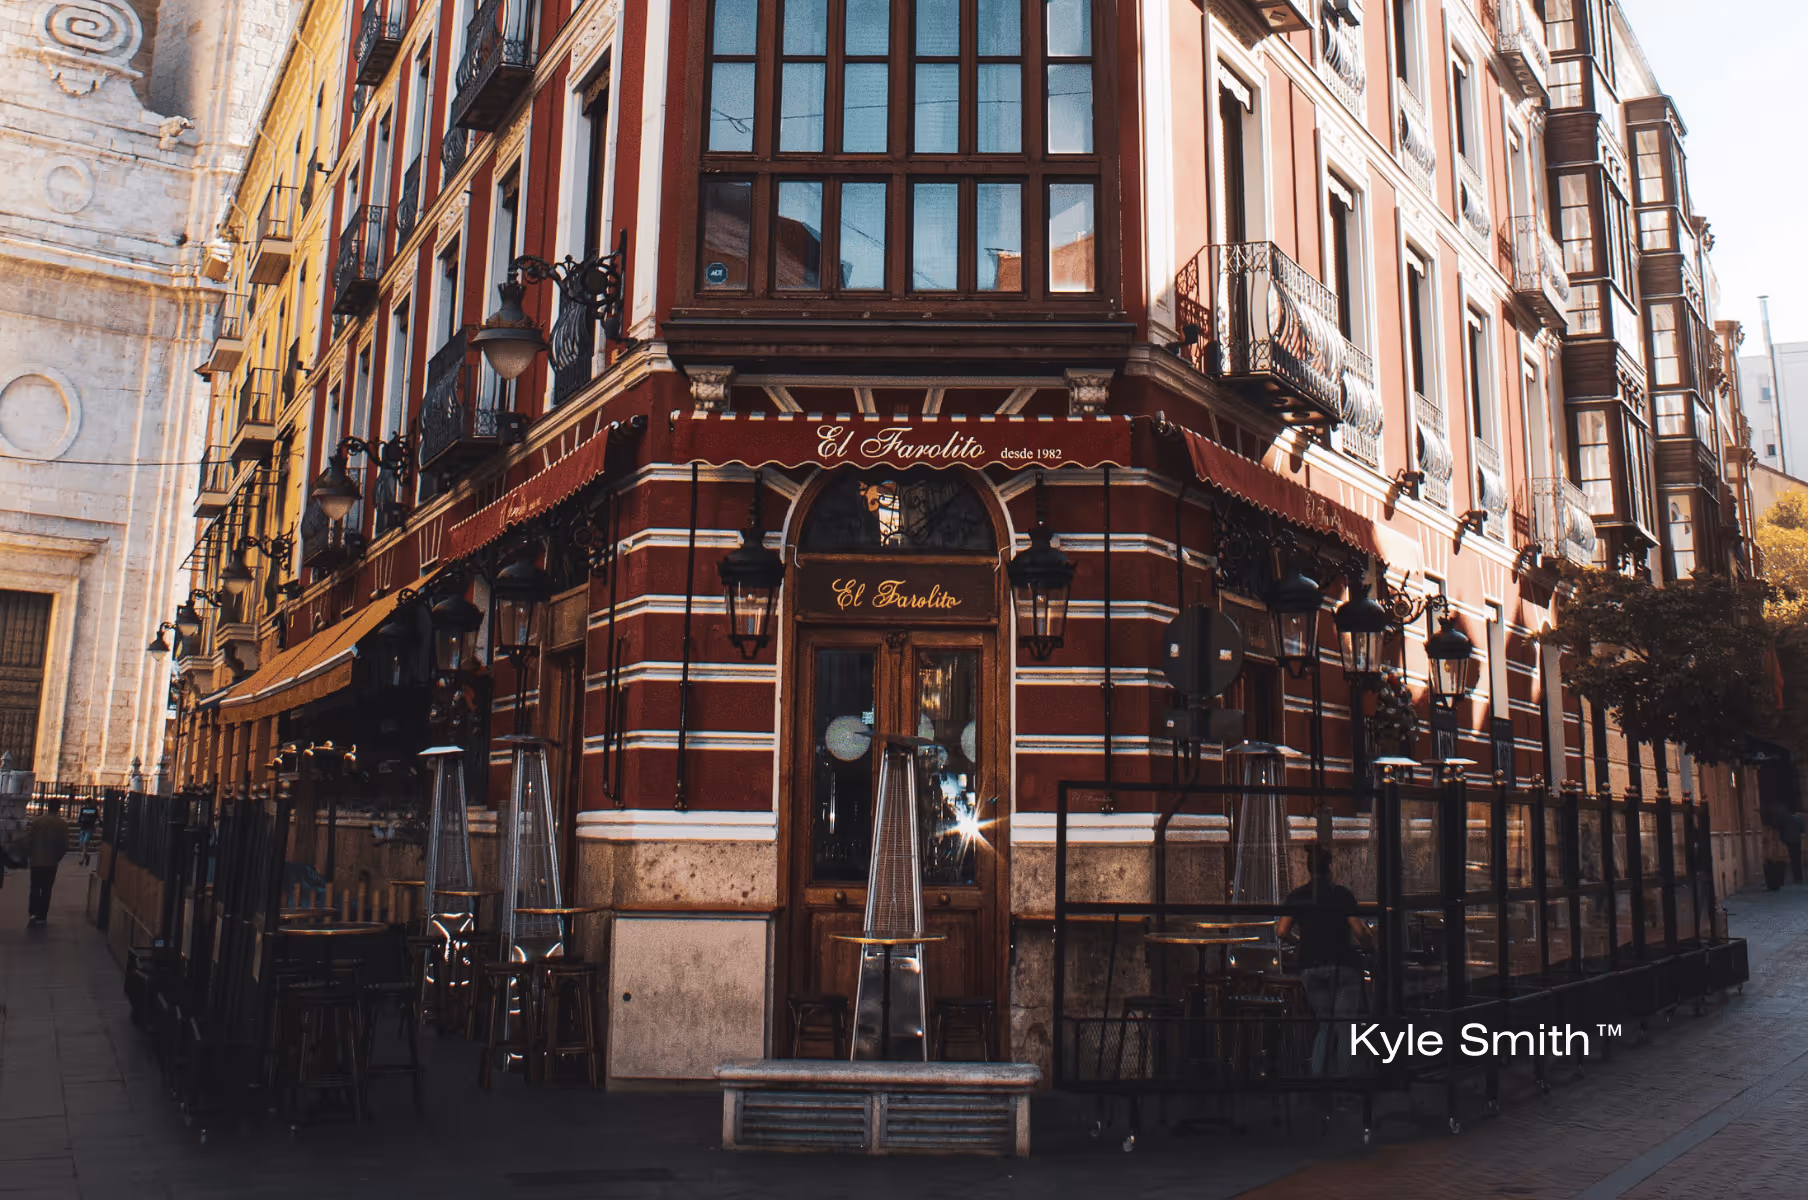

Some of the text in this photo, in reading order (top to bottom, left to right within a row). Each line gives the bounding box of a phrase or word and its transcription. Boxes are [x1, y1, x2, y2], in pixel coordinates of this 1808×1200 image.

[816, 424, 1062, 460] El Farolito desde 1982
[831, 578, 962, 611] El Farolito
